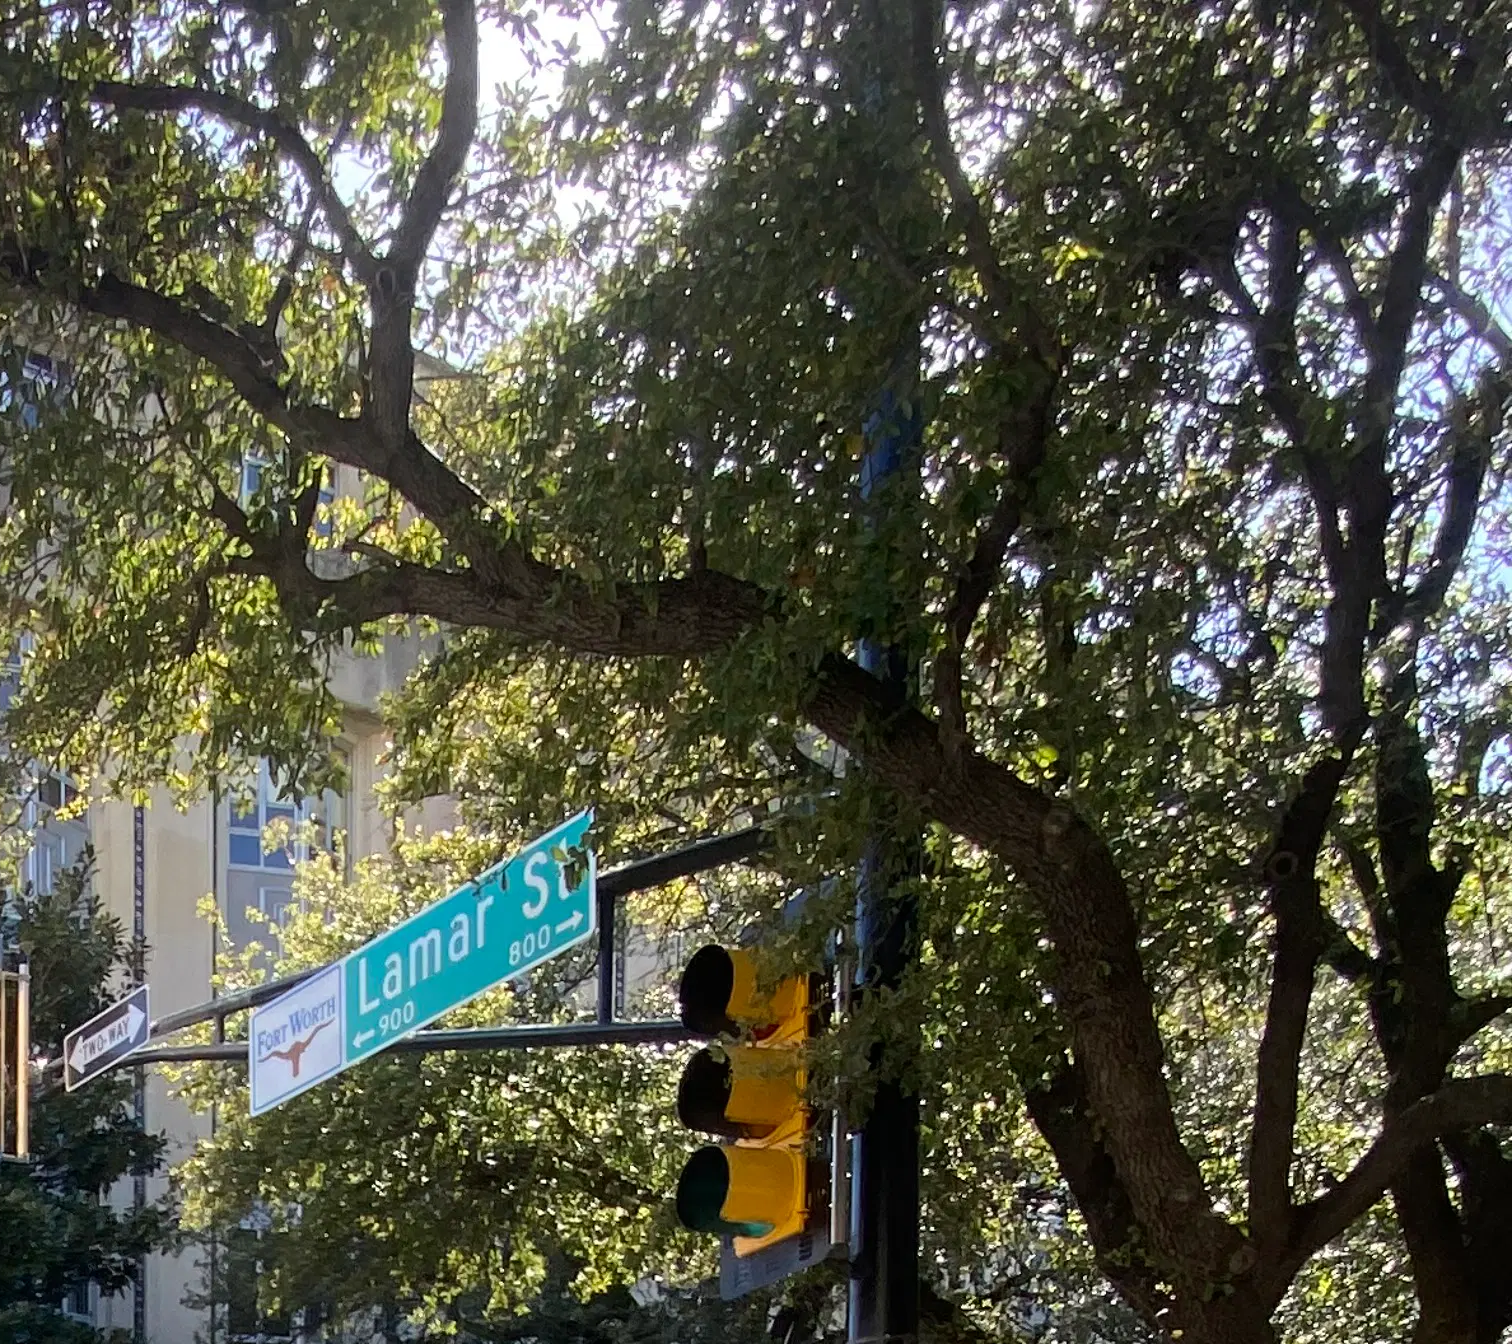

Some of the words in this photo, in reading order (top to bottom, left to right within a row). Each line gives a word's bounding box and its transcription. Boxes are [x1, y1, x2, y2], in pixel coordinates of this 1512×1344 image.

[358, 895, 494, 1016] Lamar
[521, 837, 576, 919] St
[508, 924, 551, 966] 800
[82, 1014, 131, 1062] TWO-WAY
[379, 1001, 415, 1035] 900
